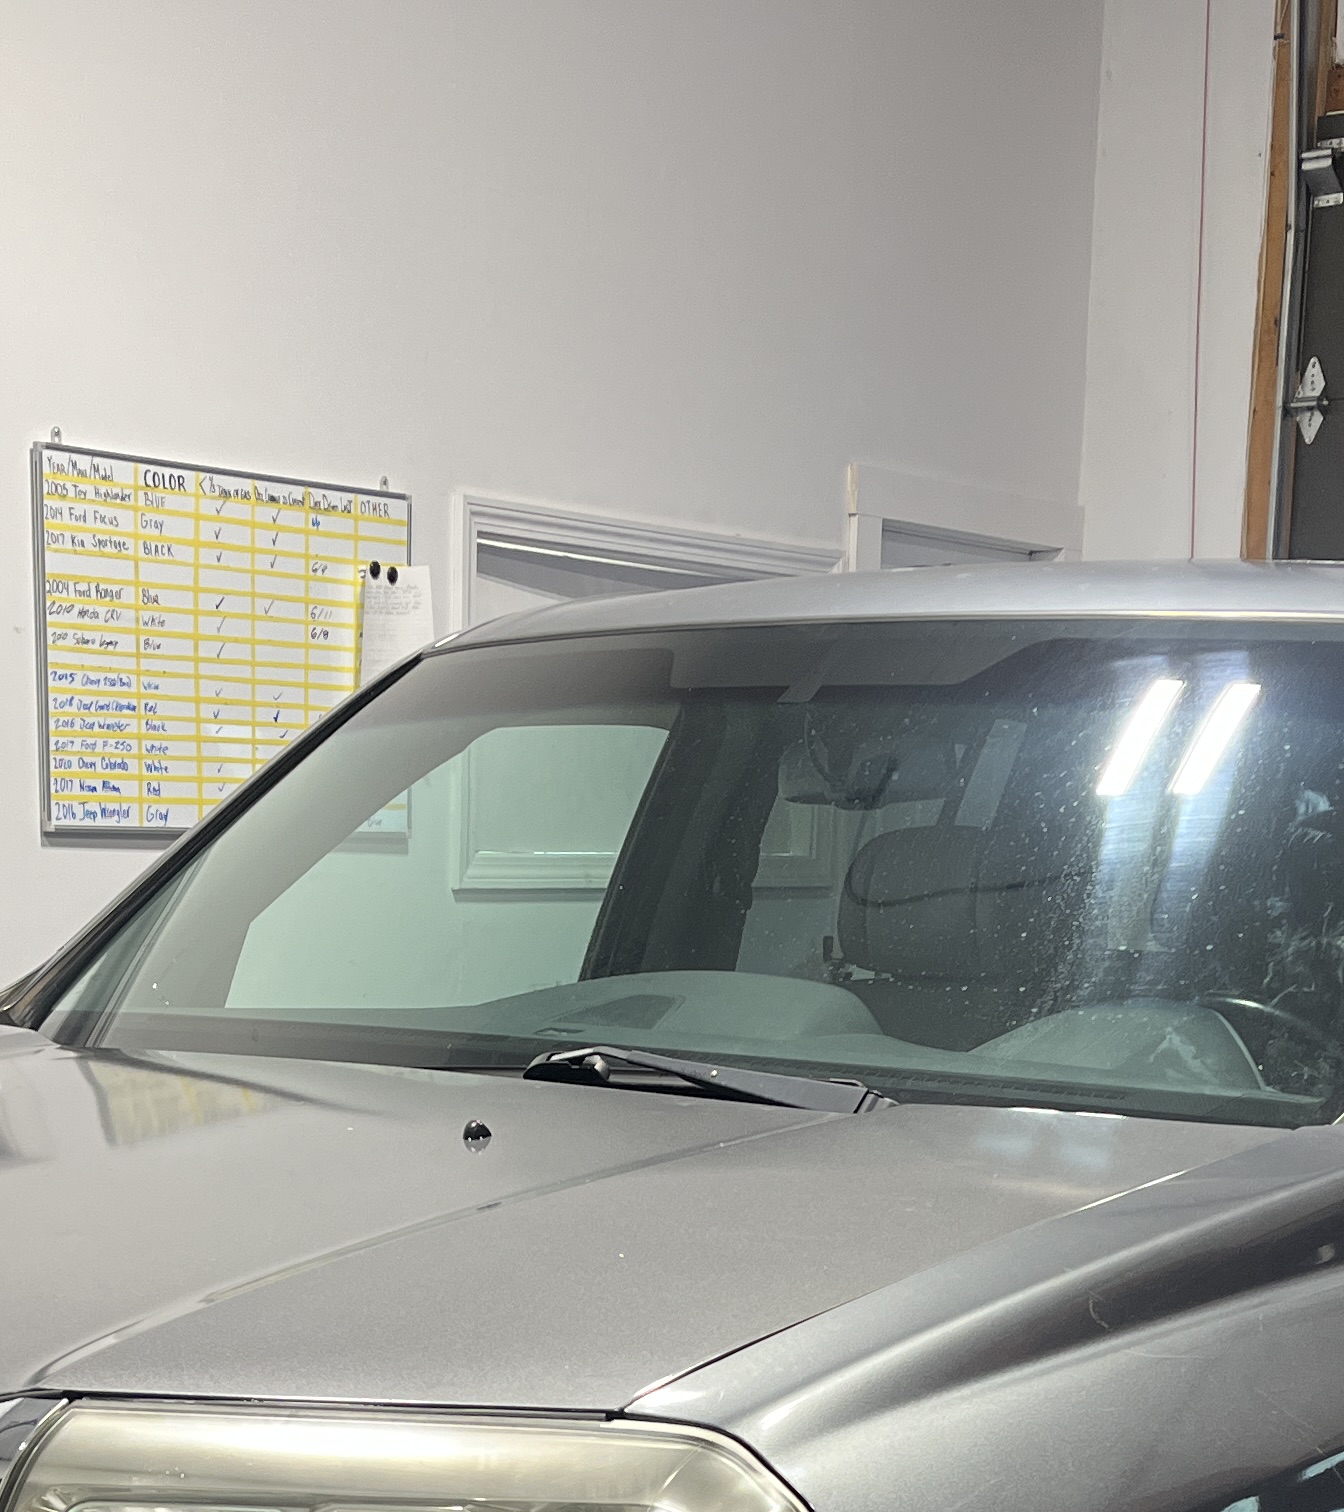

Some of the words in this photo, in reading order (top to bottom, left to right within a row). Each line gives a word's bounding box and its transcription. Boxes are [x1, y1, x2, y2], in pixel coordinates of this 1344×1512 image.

[45, 480, 68, 497] 2005
[94, 486, 132, 502] Highlander
[144, 469, 187, 492] COLOR
[44, 503, 63, 522] 2014
[68, 506, 87, 524] Ford
[94, 510, 119, 528] Focus
[360, 501, 390, 518] OTHER
[141, 512, 164, 536] Gray
[46, 530, 65, 546] 2017
[70, 533, 86, 549] Kia
[92, 534, 129, 552] Sportage
[46, 580, 69, 597] 2004
[74, 581, 91, 599] Ford
[95, 582, 124, 602] Ranger
[142, 588, 161, 606] Blue
[104, 609, 121, 623] CRV
[53, 778, 74, 793] 2017
[146, 781, 161, 797] Red
[55, 802, 76, 821] 2016
[77, 801, 98, 822] Jeep
[98, 801, 131, 823] Wrangler
[146, 805, 169, 825] Gray
